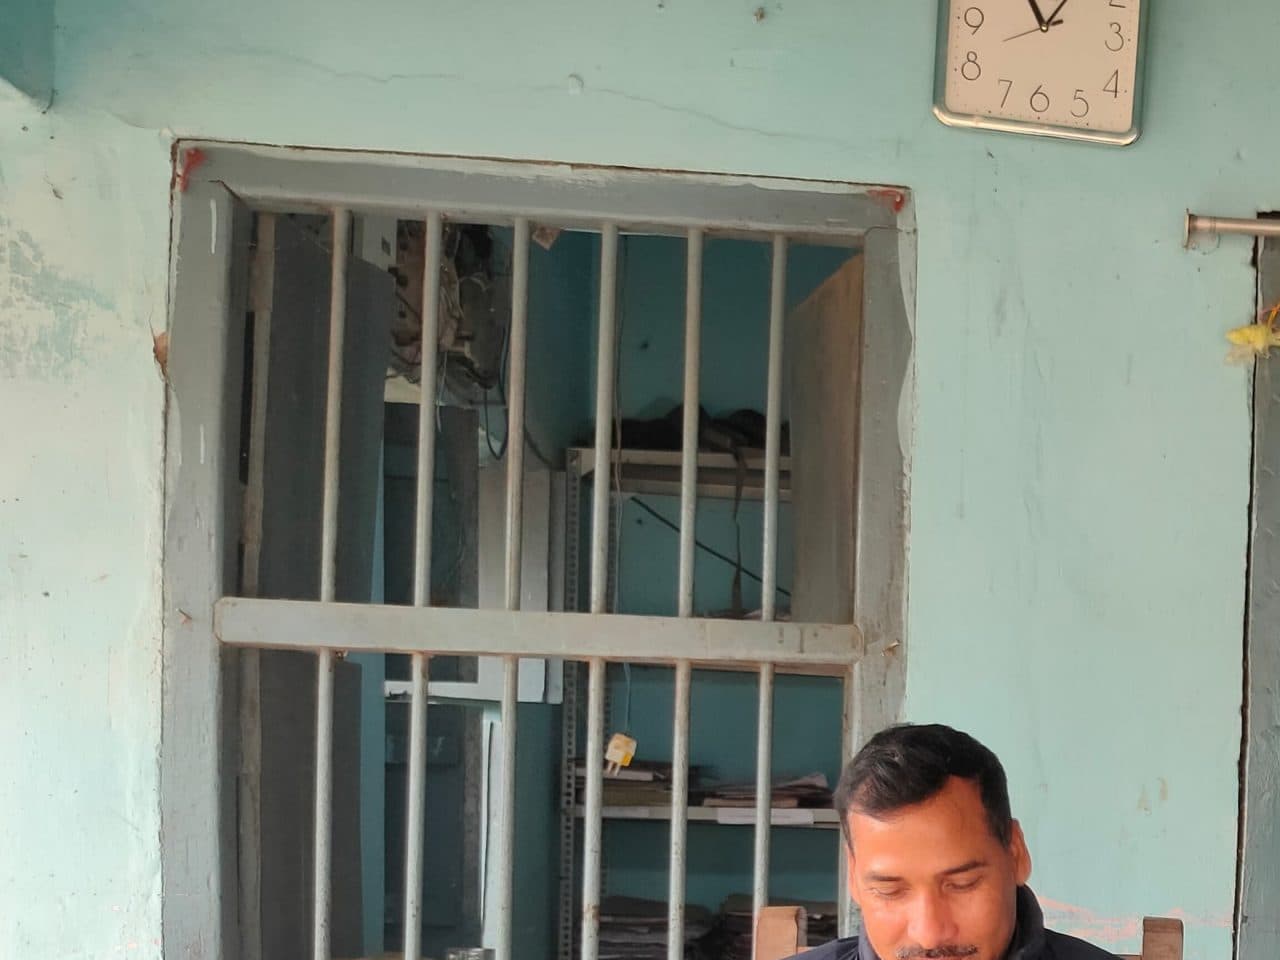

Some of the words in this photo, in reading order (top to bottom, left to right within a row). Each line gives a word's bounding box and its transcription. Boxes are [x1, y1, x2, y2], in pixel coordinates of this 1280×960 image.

[964, 7, 984, 35] 9
[1105, 22, 1124, 51] 3
[961, 51, 981, 81] 8
[998, 79, 1012, 108] 7
[1102, 69, 1120, 98] 4
[1030, 85, 1050, 113] 6
[1070, 89, 1089, 117] 5
